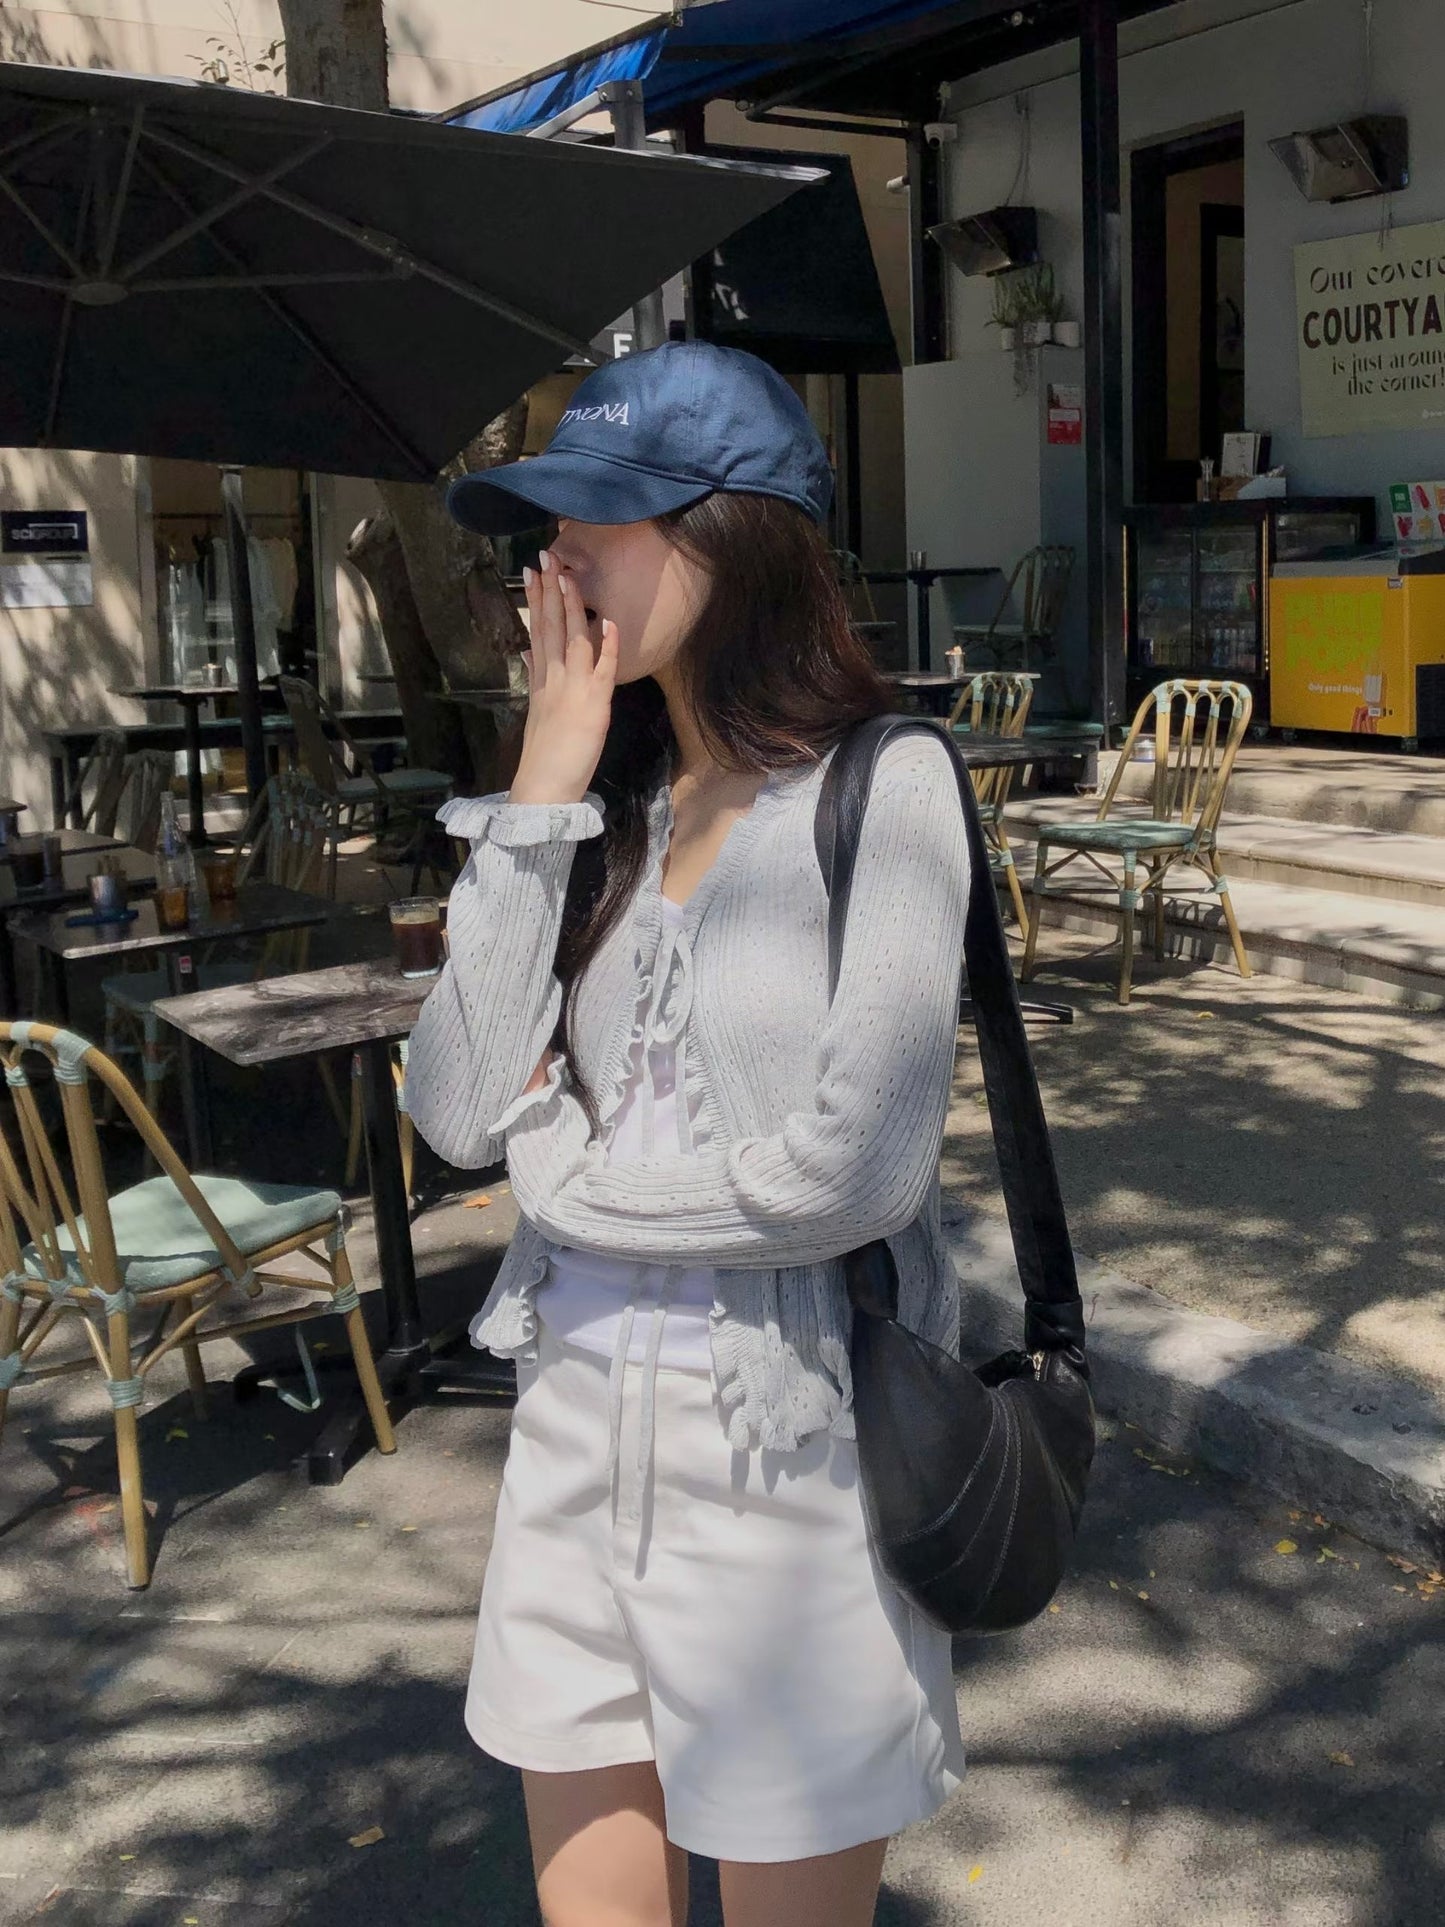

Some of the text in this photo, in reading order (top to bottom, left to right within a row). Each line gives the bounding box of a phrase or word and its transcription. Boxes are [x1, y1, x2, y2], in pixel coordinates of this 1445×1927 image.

[1310, 266, 1352, 293] Our
[1303, 294, 1445, 349] COURTYA
[1332, 349, 1445, 380] is just aroun
[1348, 366, 1445, 396] the corner!
